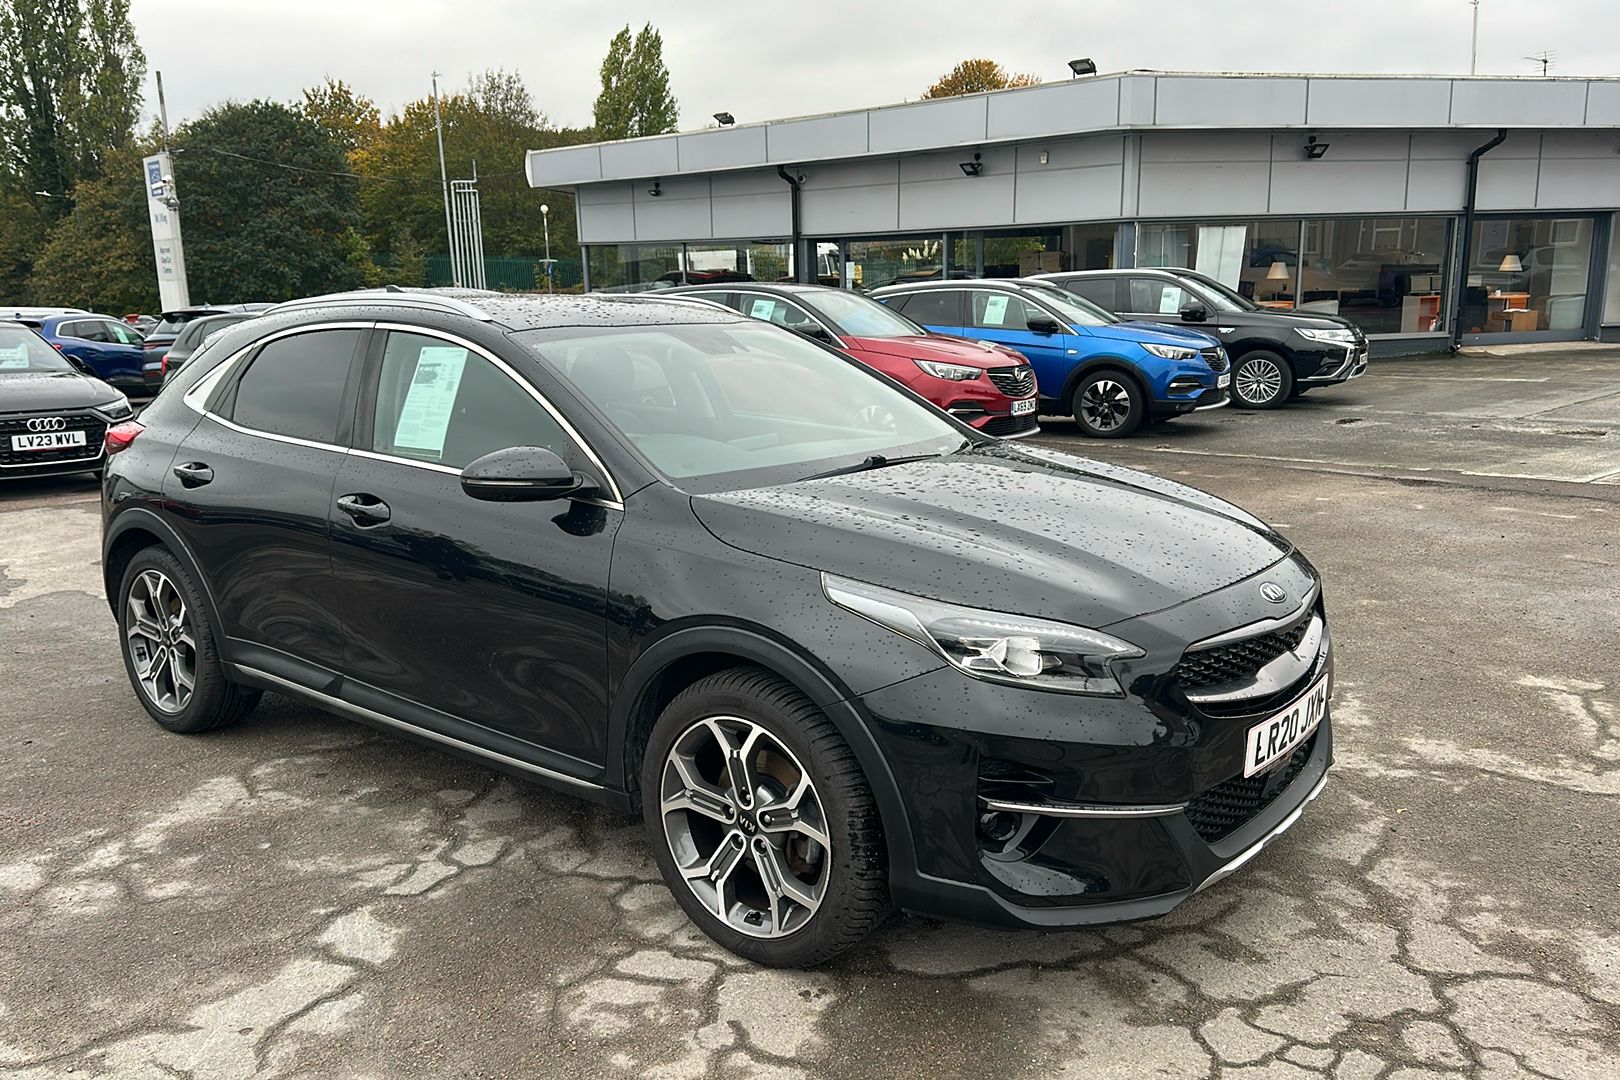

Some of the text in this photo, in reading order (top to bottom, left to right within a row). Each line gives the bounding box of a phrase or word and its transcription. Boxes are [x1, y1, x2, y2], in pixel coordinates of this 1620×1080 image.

[18, 433, 80, 448] LV23 WVL
[1254, 708, 1300, 767] LR20
[740, 815, 756, 832] KIA
